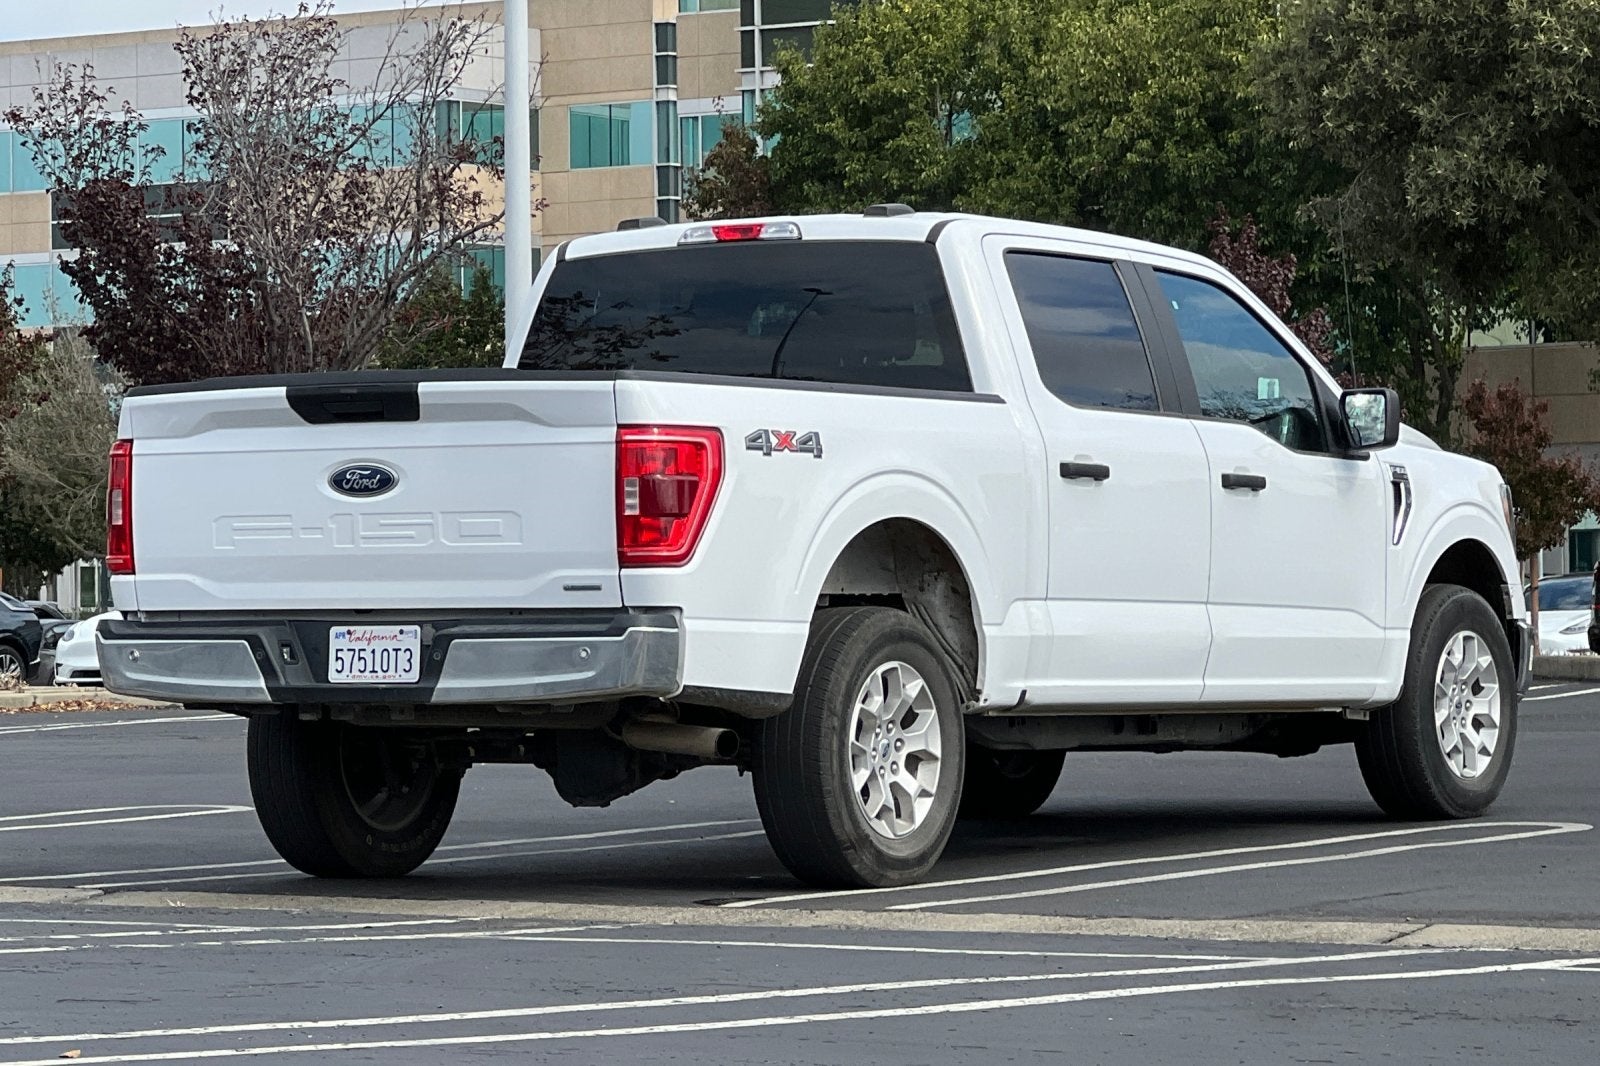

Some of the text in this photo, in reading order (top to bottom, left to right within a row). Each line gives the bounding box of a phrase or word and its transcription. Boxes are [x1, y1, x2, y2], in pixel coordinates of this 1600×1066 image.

[343, 469, 380, 490] Ford
[212, 511, 523, 550] F-150
[348, 630, 403, 646] California
[335, 648, 413, 674] 57510T3
